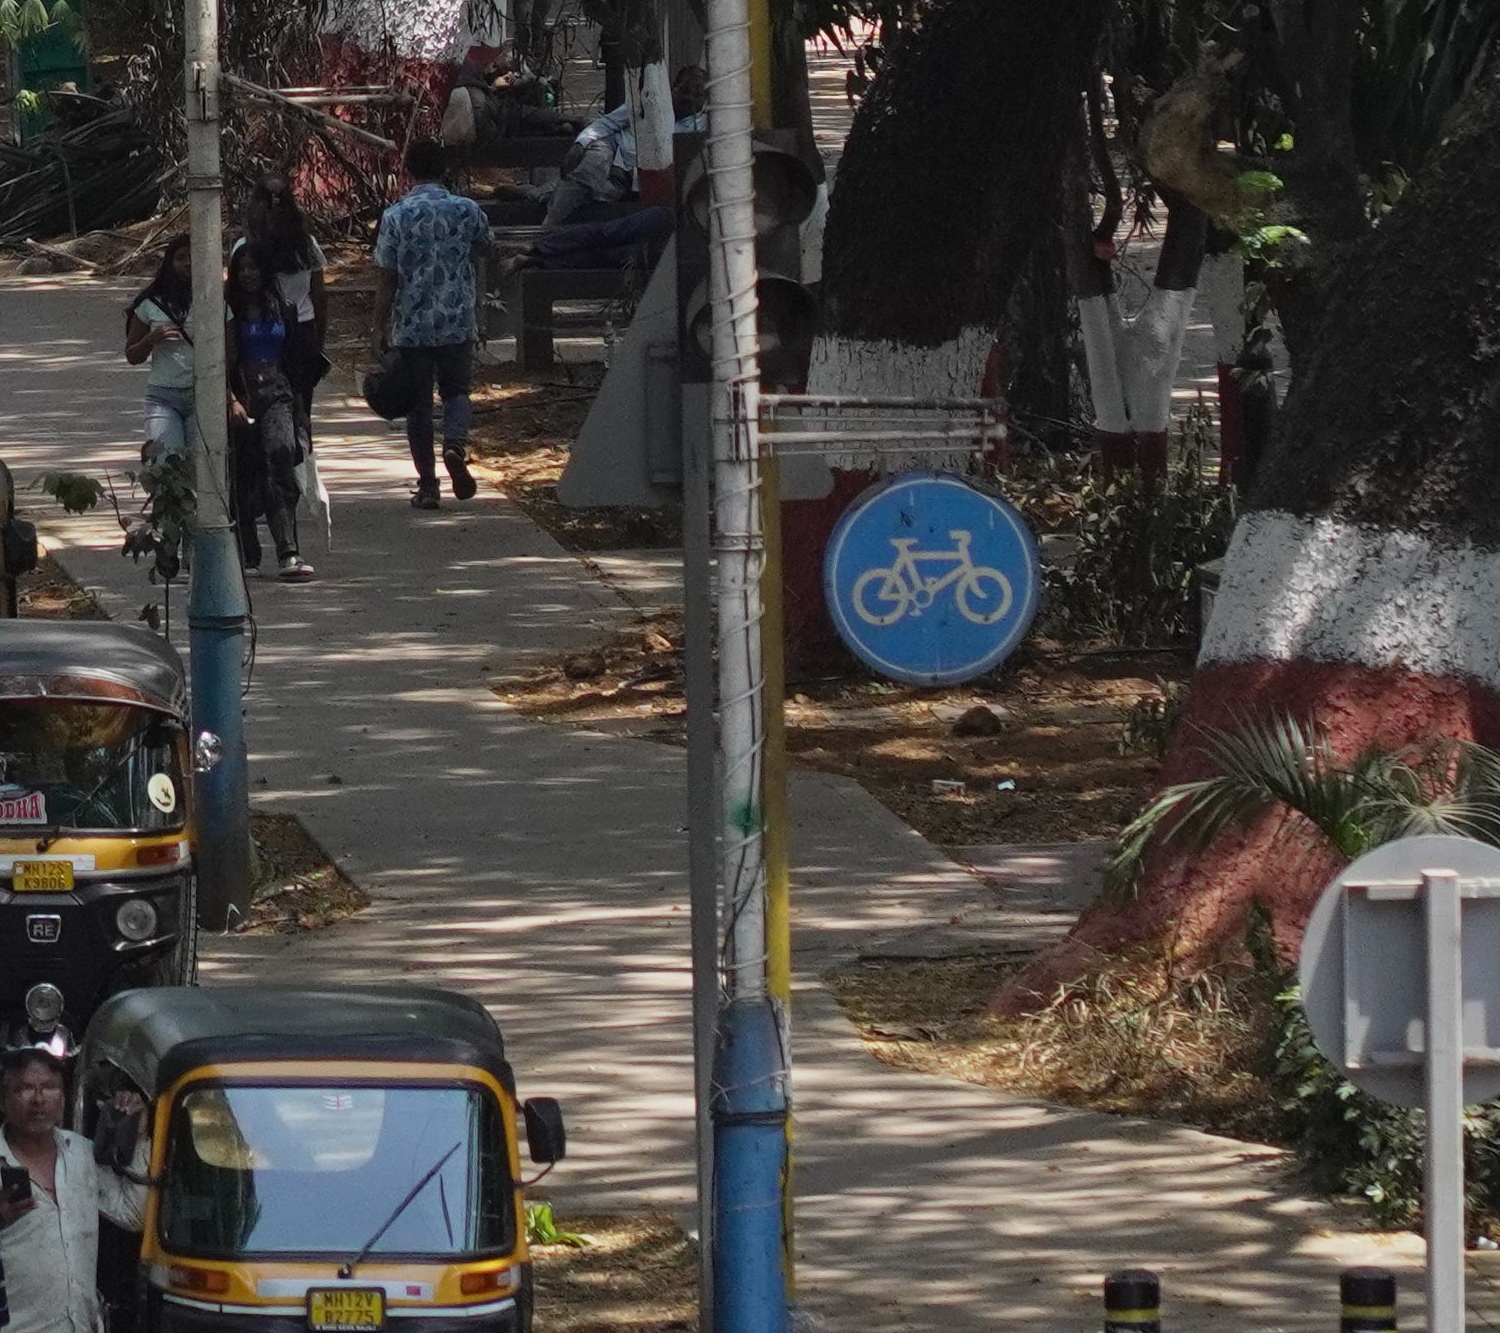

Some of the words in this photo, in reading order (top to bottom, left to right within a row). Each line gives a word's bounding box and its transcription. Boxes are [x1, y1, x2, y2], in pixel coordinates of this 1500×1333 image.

[24, 863, 65, 876] MH12S
[33, 924, 55, 937] RE
[324, 1293, 373, 1308] MH12V
[324, 1310, 375, 1325] B2775
